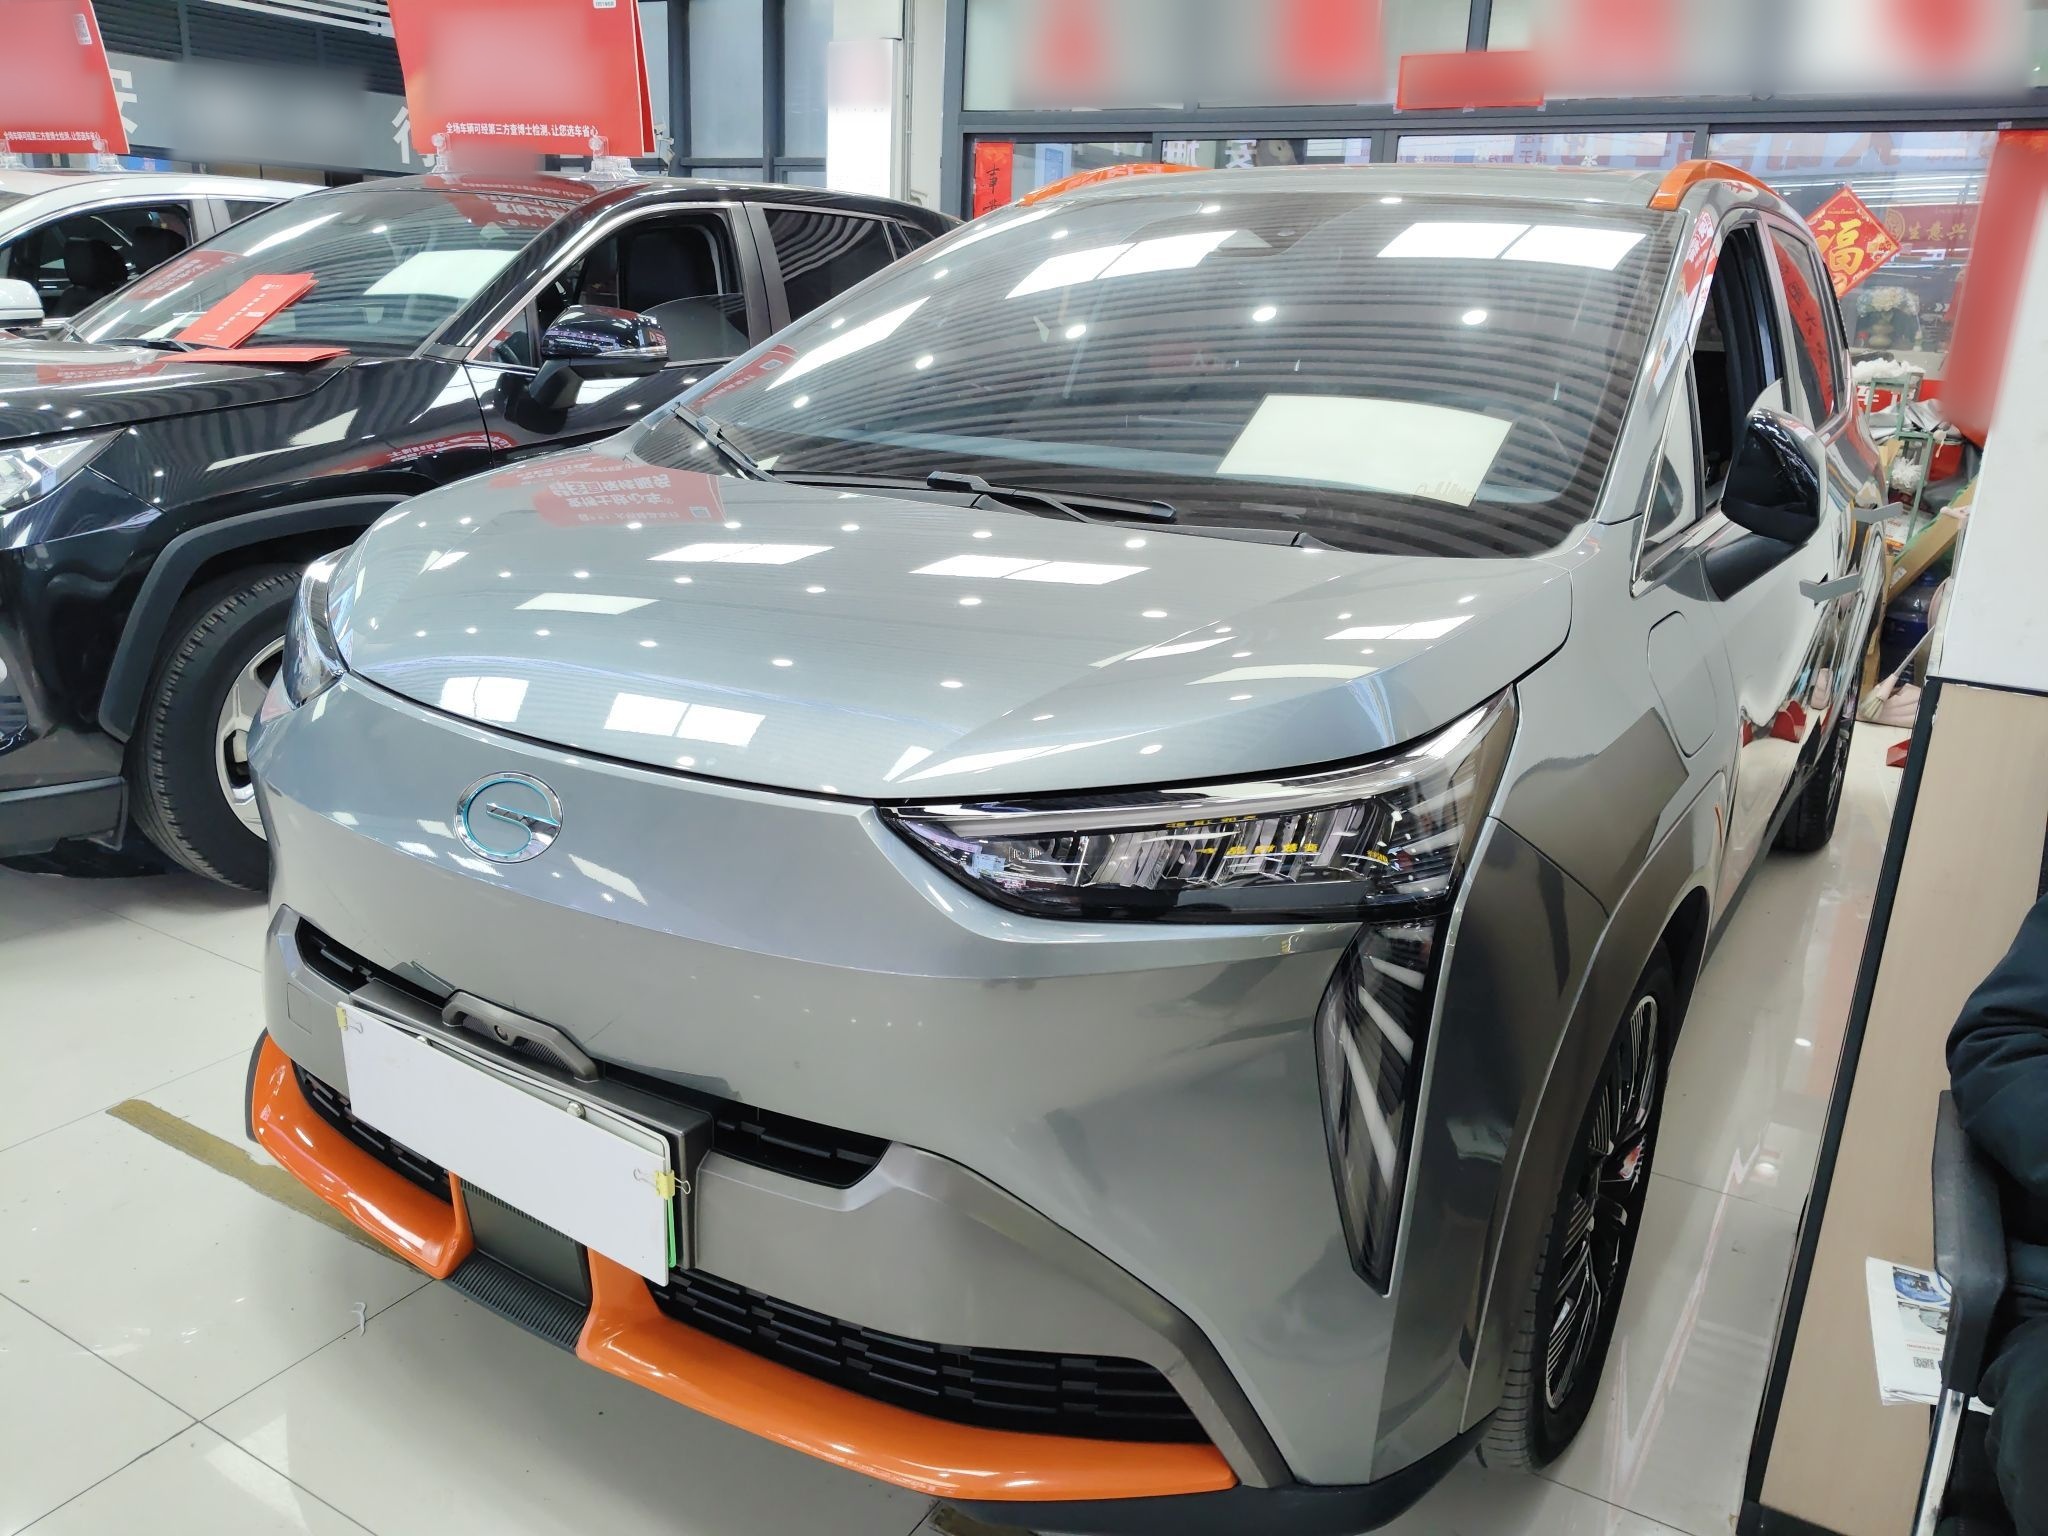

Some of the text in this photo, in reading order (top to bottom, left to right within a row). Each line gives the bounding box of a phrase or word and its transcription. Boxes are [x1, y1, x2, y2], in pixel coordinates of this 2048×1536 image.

[1815, 218, 1865, 275] 福
[1908, 221, 1973, 241] 生意兴
